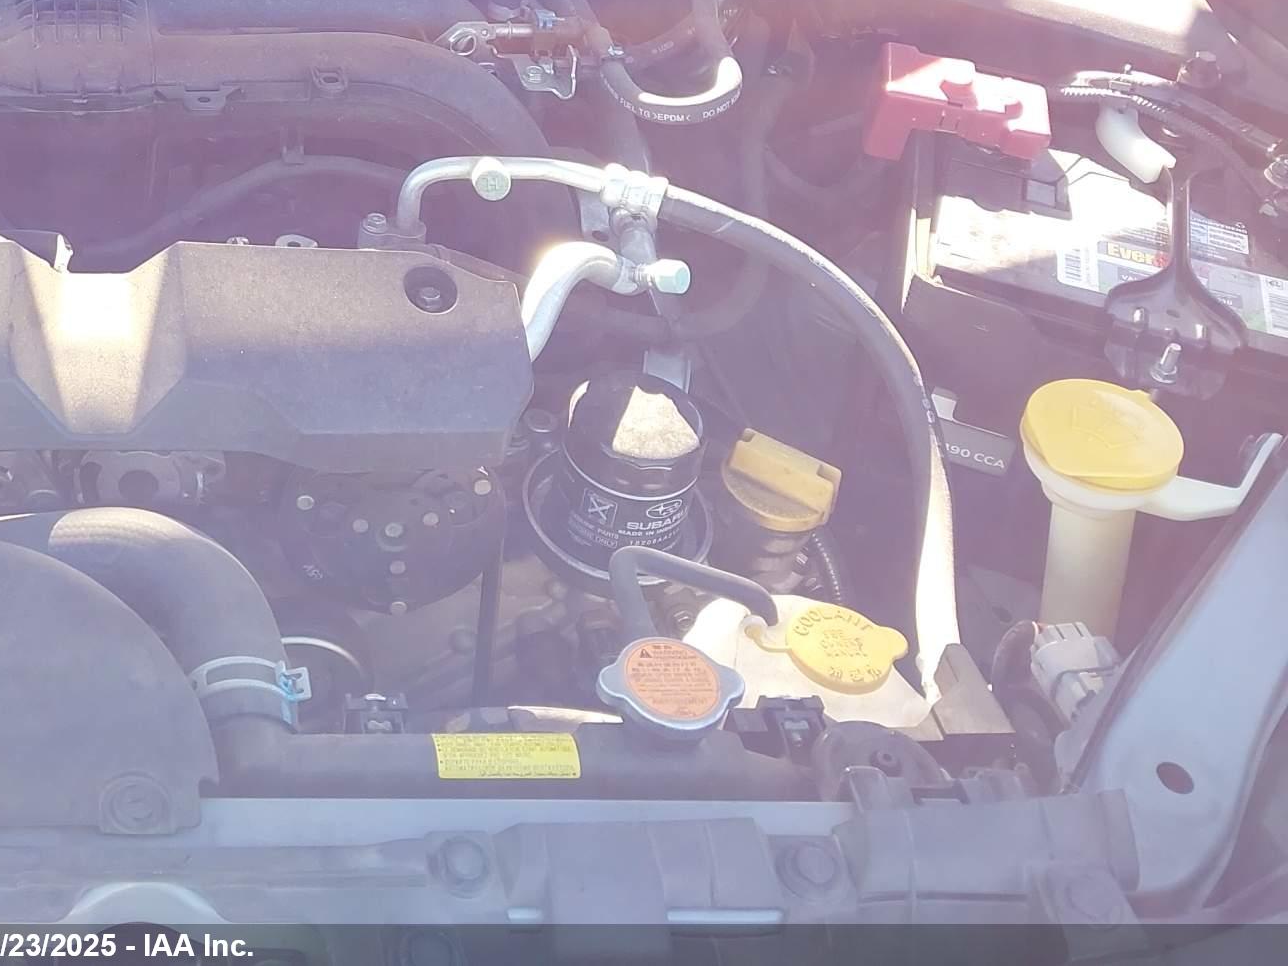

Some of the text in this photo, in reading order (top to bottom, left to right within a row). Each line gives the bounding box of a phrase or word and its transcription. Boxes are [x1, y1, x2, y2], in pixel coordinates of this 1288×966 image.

[702, 109, 716, 120] DO
[716, 102, 731, 115] NOT
[973, 452, 1006, 470] CCA
[793, 610, 875, 637] COOLANT
